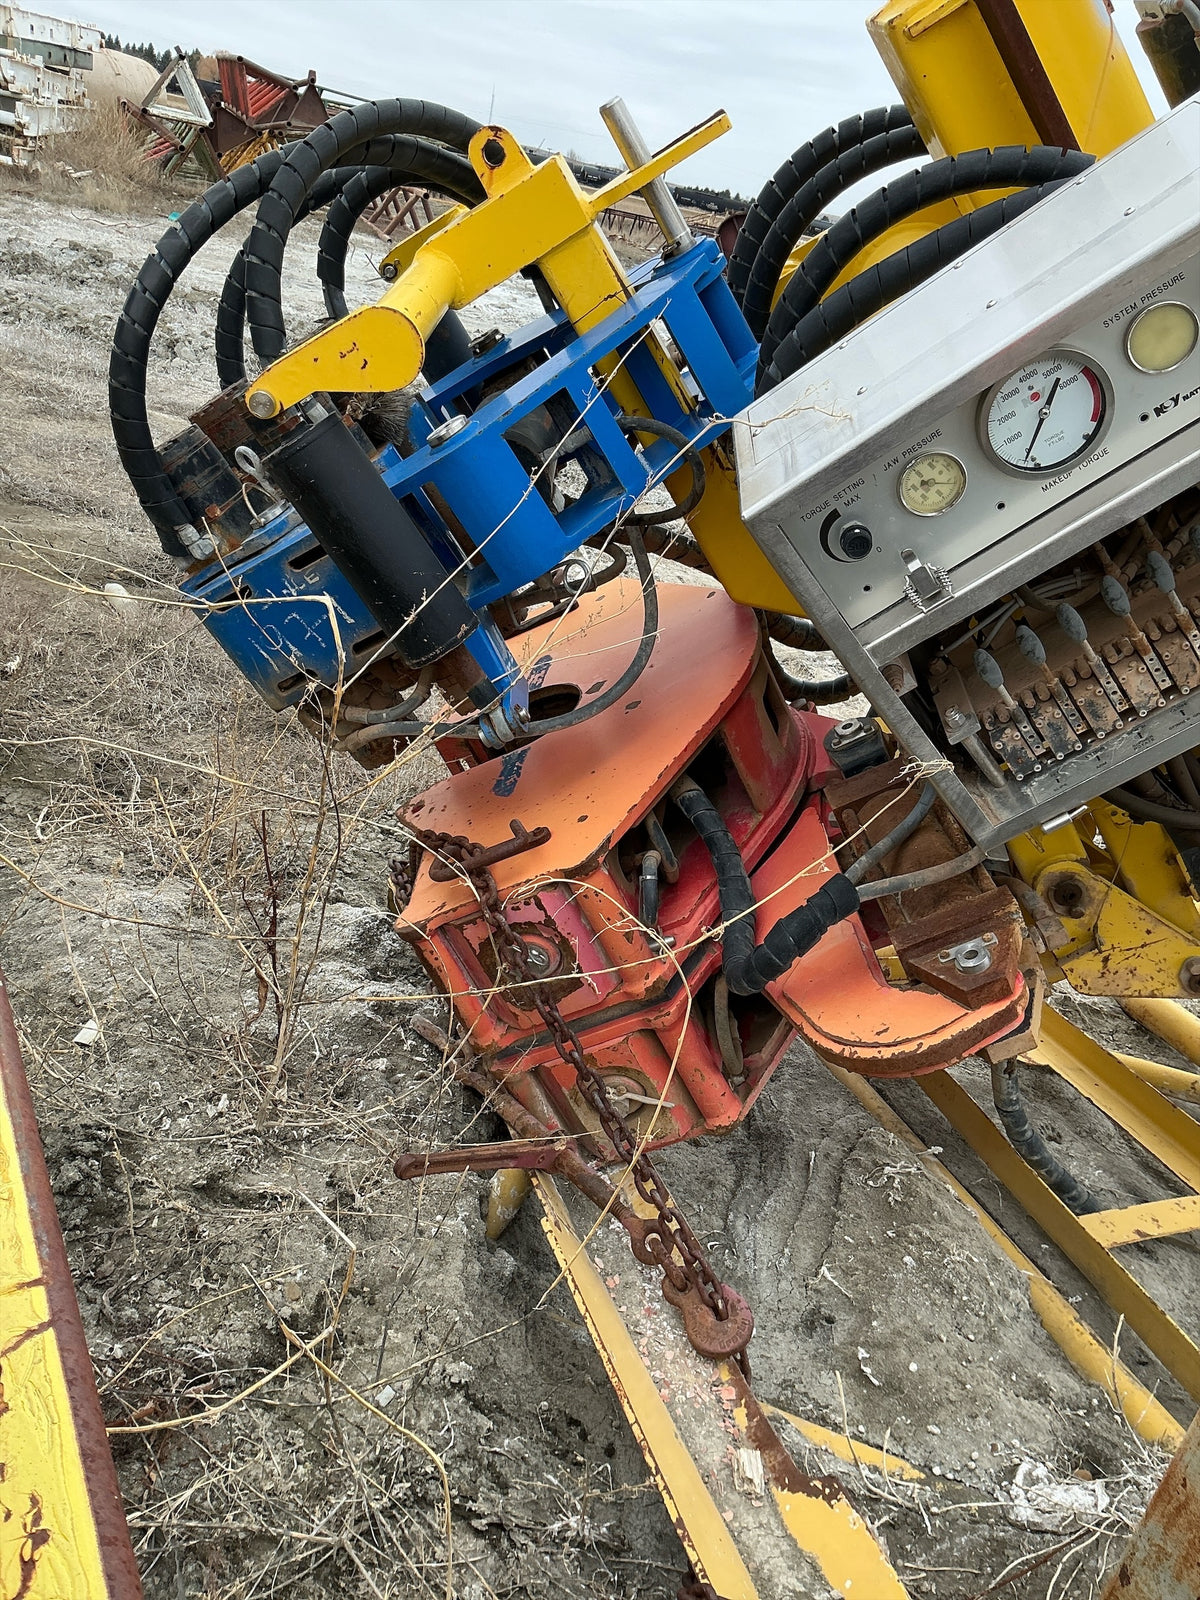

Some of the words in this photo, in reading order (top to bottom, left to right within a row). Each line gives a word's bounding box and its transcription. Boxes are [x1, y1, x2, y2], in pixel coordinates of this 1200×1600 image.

[1102, 302, 1139, 329] SYSTEM
[1140, 271, 1186, 305] PRESSURE
[1018, 368, 1039, 384] 40000
[1041, 363, 1063, 379] 50000
[1058, 374, 1079, 390] 60000
[1000, 386, 1020, 403] 30000
[996, 410, 1017, 426] 20000
[1003, 431, 1023, 446] 10000
[882, 457, 900, 472] JAW
[901, 428, 943, 459] PRESSURE
[800, 499, 832, 523] TORQUE
[832, 477, 865, 502] SETTING
[843, 493, 862, 508] MAX
